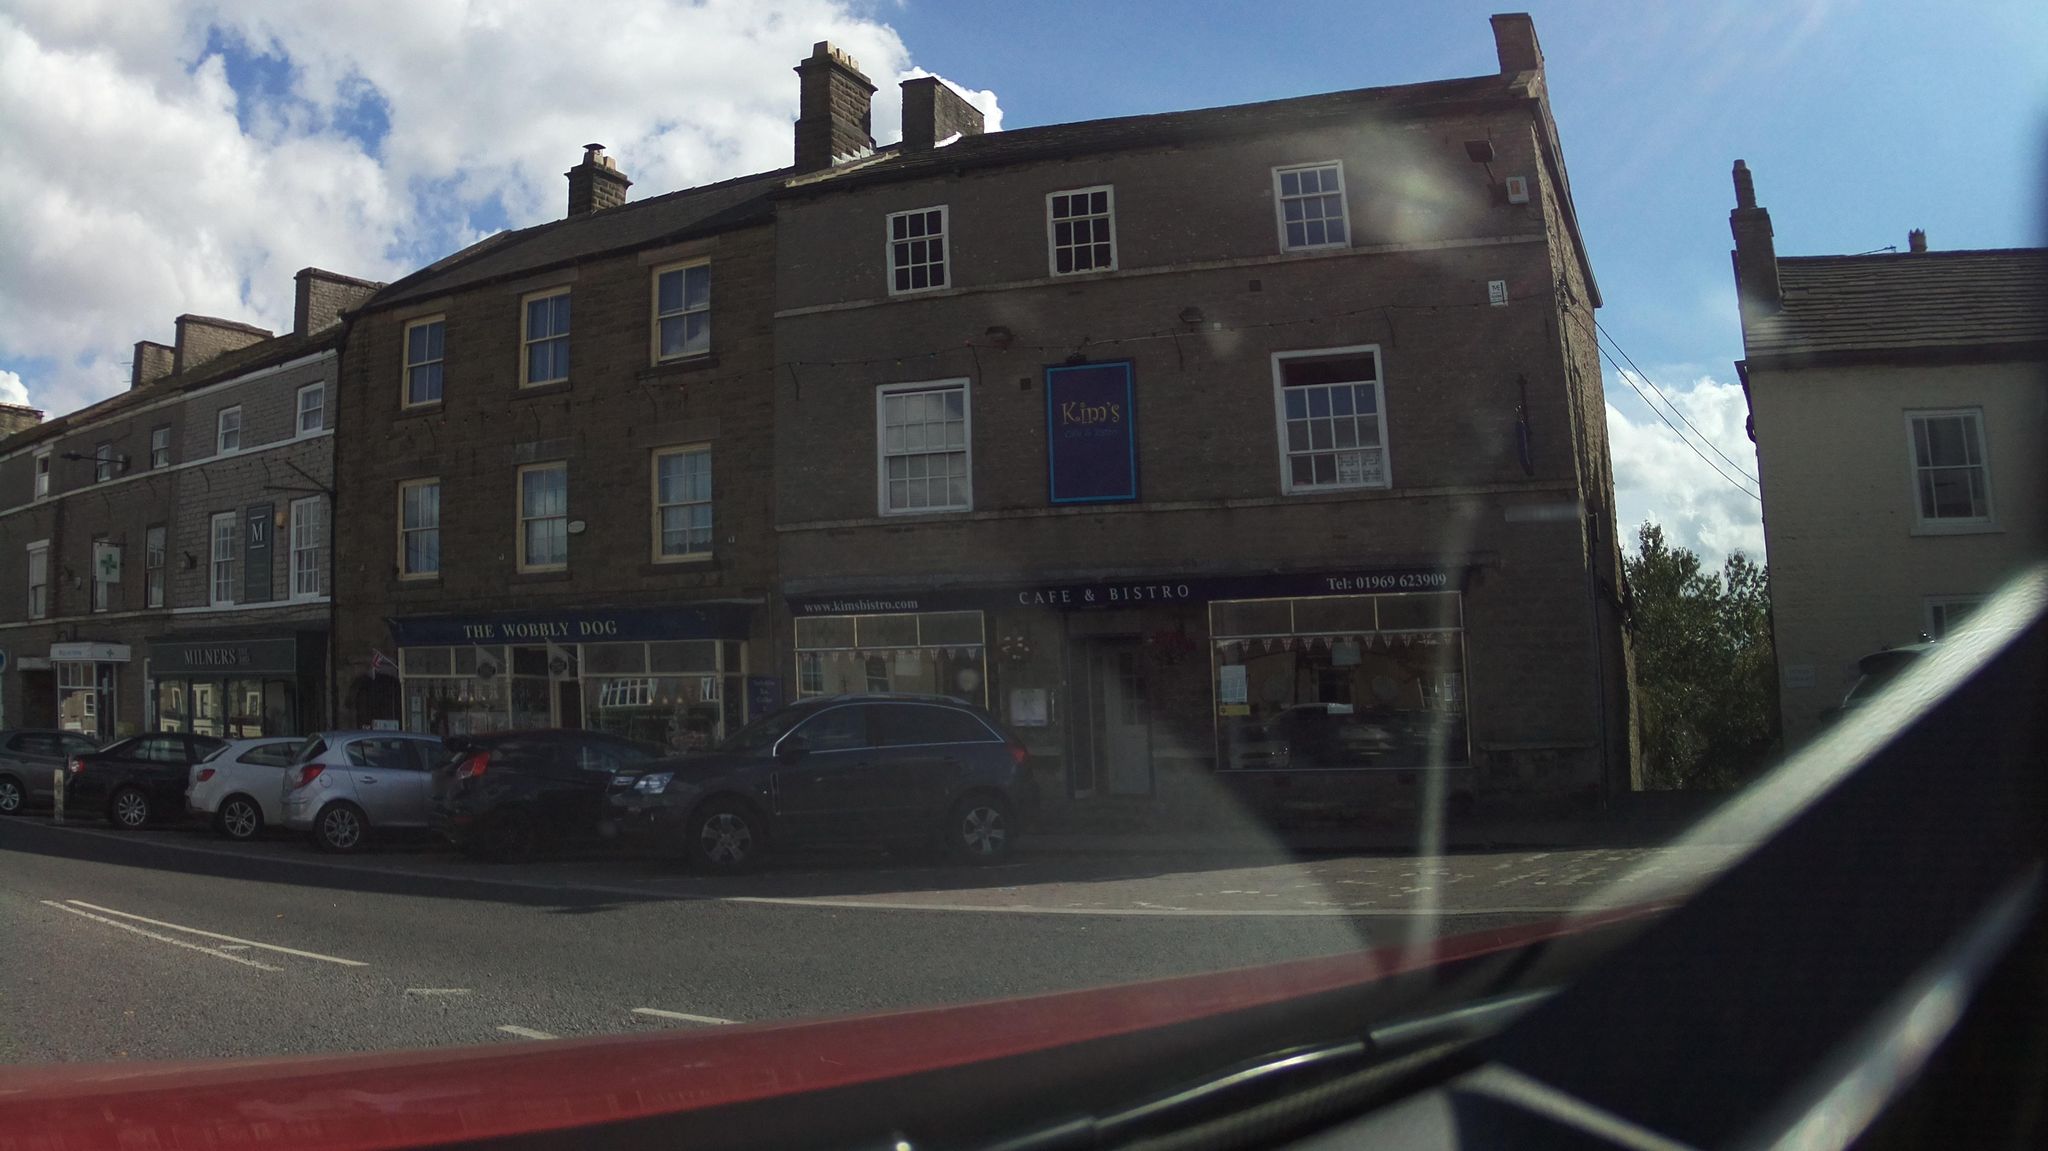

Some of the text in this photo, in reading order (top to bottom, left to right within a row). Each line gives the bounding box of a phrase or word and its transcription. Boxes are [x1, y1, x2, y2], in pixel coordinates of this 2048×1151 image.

[1060, 402, 1120, 424] Kim's
[252, 522, 263, 541] M
[1326, 574, 1447, 590] Tel: 01969 623909
[1019, 585, 1189, 605] CAFE & BISTRO
[804, 600, 918, 612] www.kimsbistro.com
[464, 620, 617, 639] THE WOBBLY DOG
[184, 648, 236, 665] MILNERS
